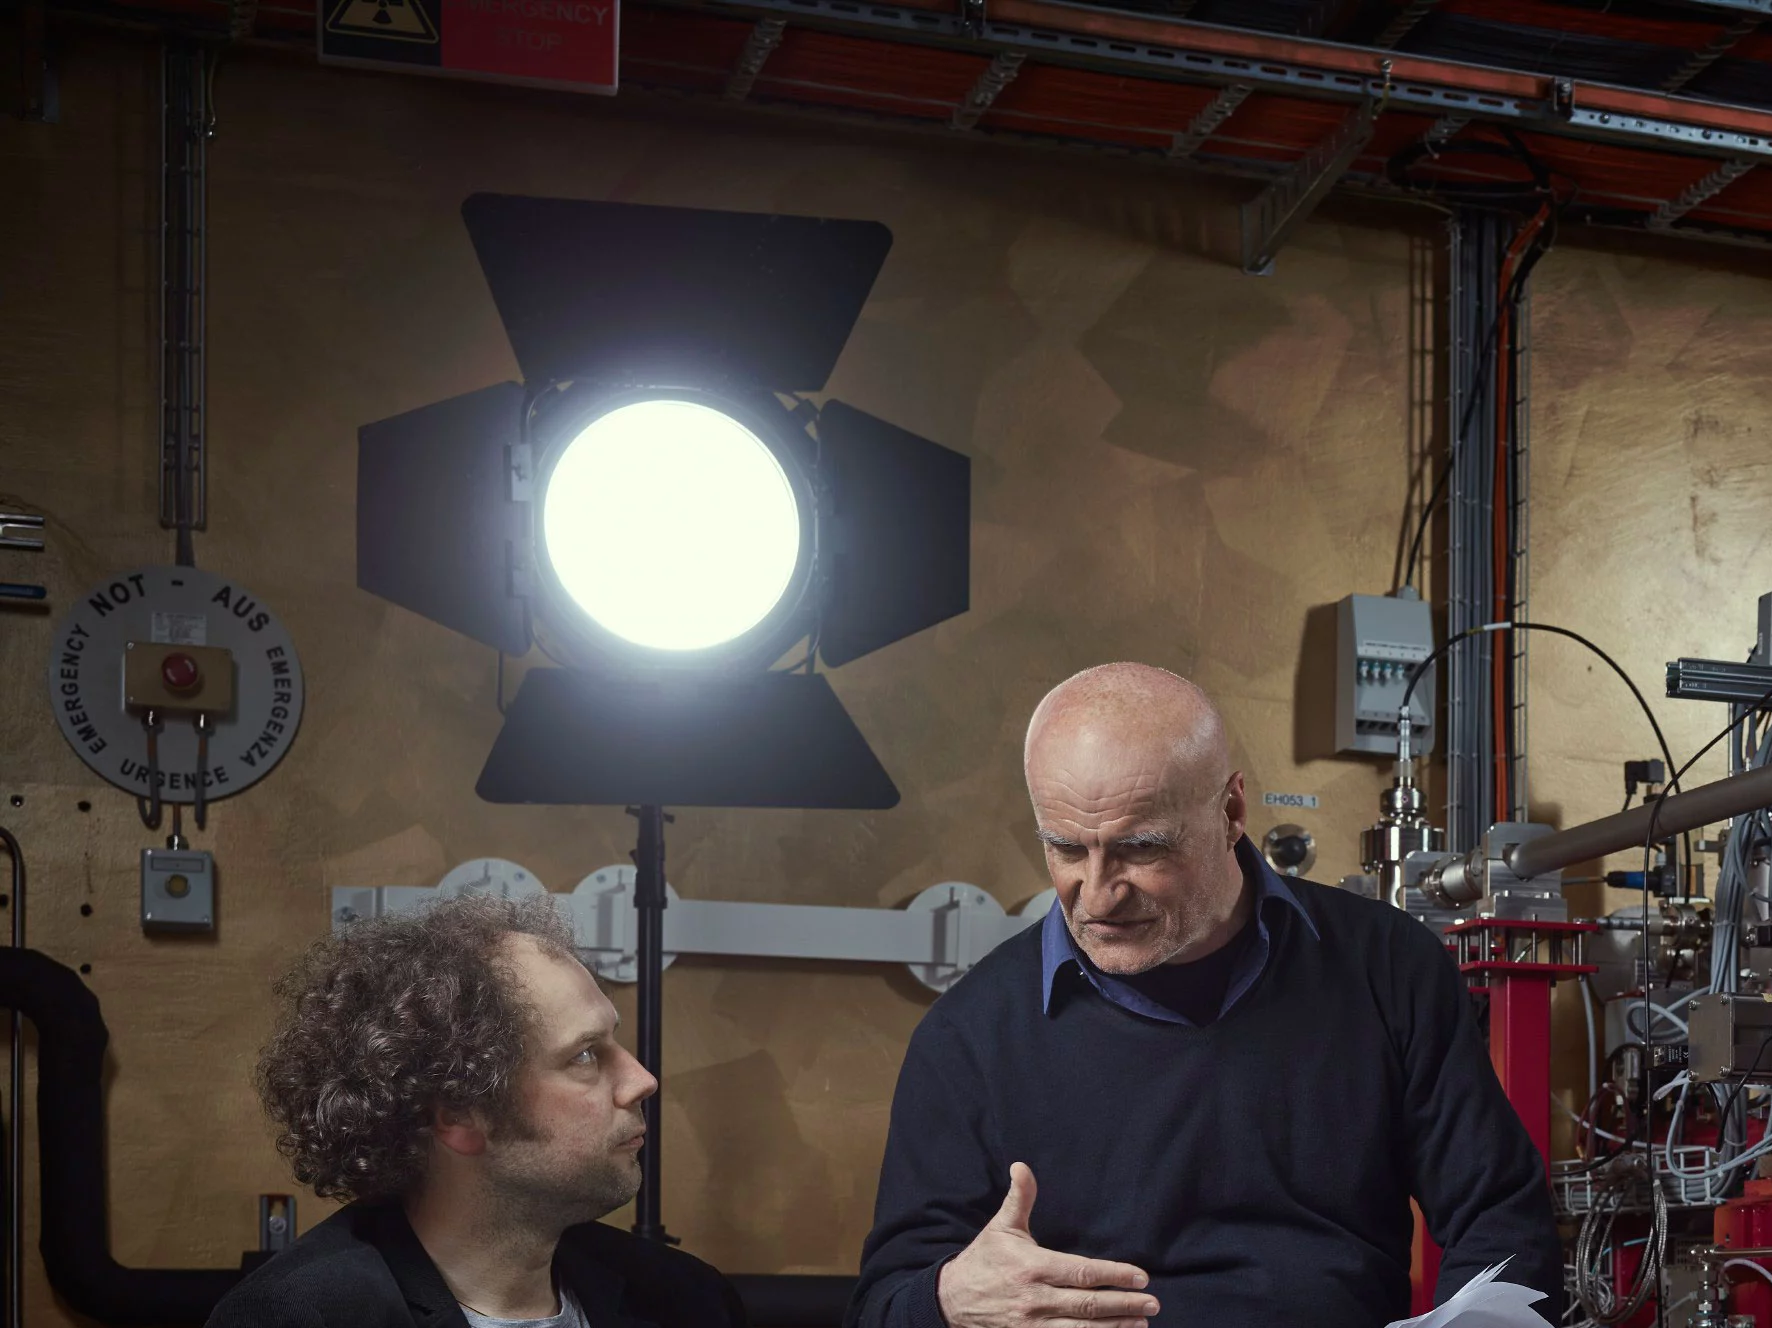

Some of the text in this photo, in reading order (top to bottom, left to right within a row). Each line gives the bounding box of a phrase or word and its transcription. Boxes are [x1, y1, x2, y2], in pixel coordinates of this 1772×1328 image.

[495, 26, 563, 50] STOP
[89, 574, 148, 618] NOT
[211, 586, 270, 634] AUS
[60, 624, 108, 755] EMERGENCY
[239, 645, 292, 767] EMERGENZA
